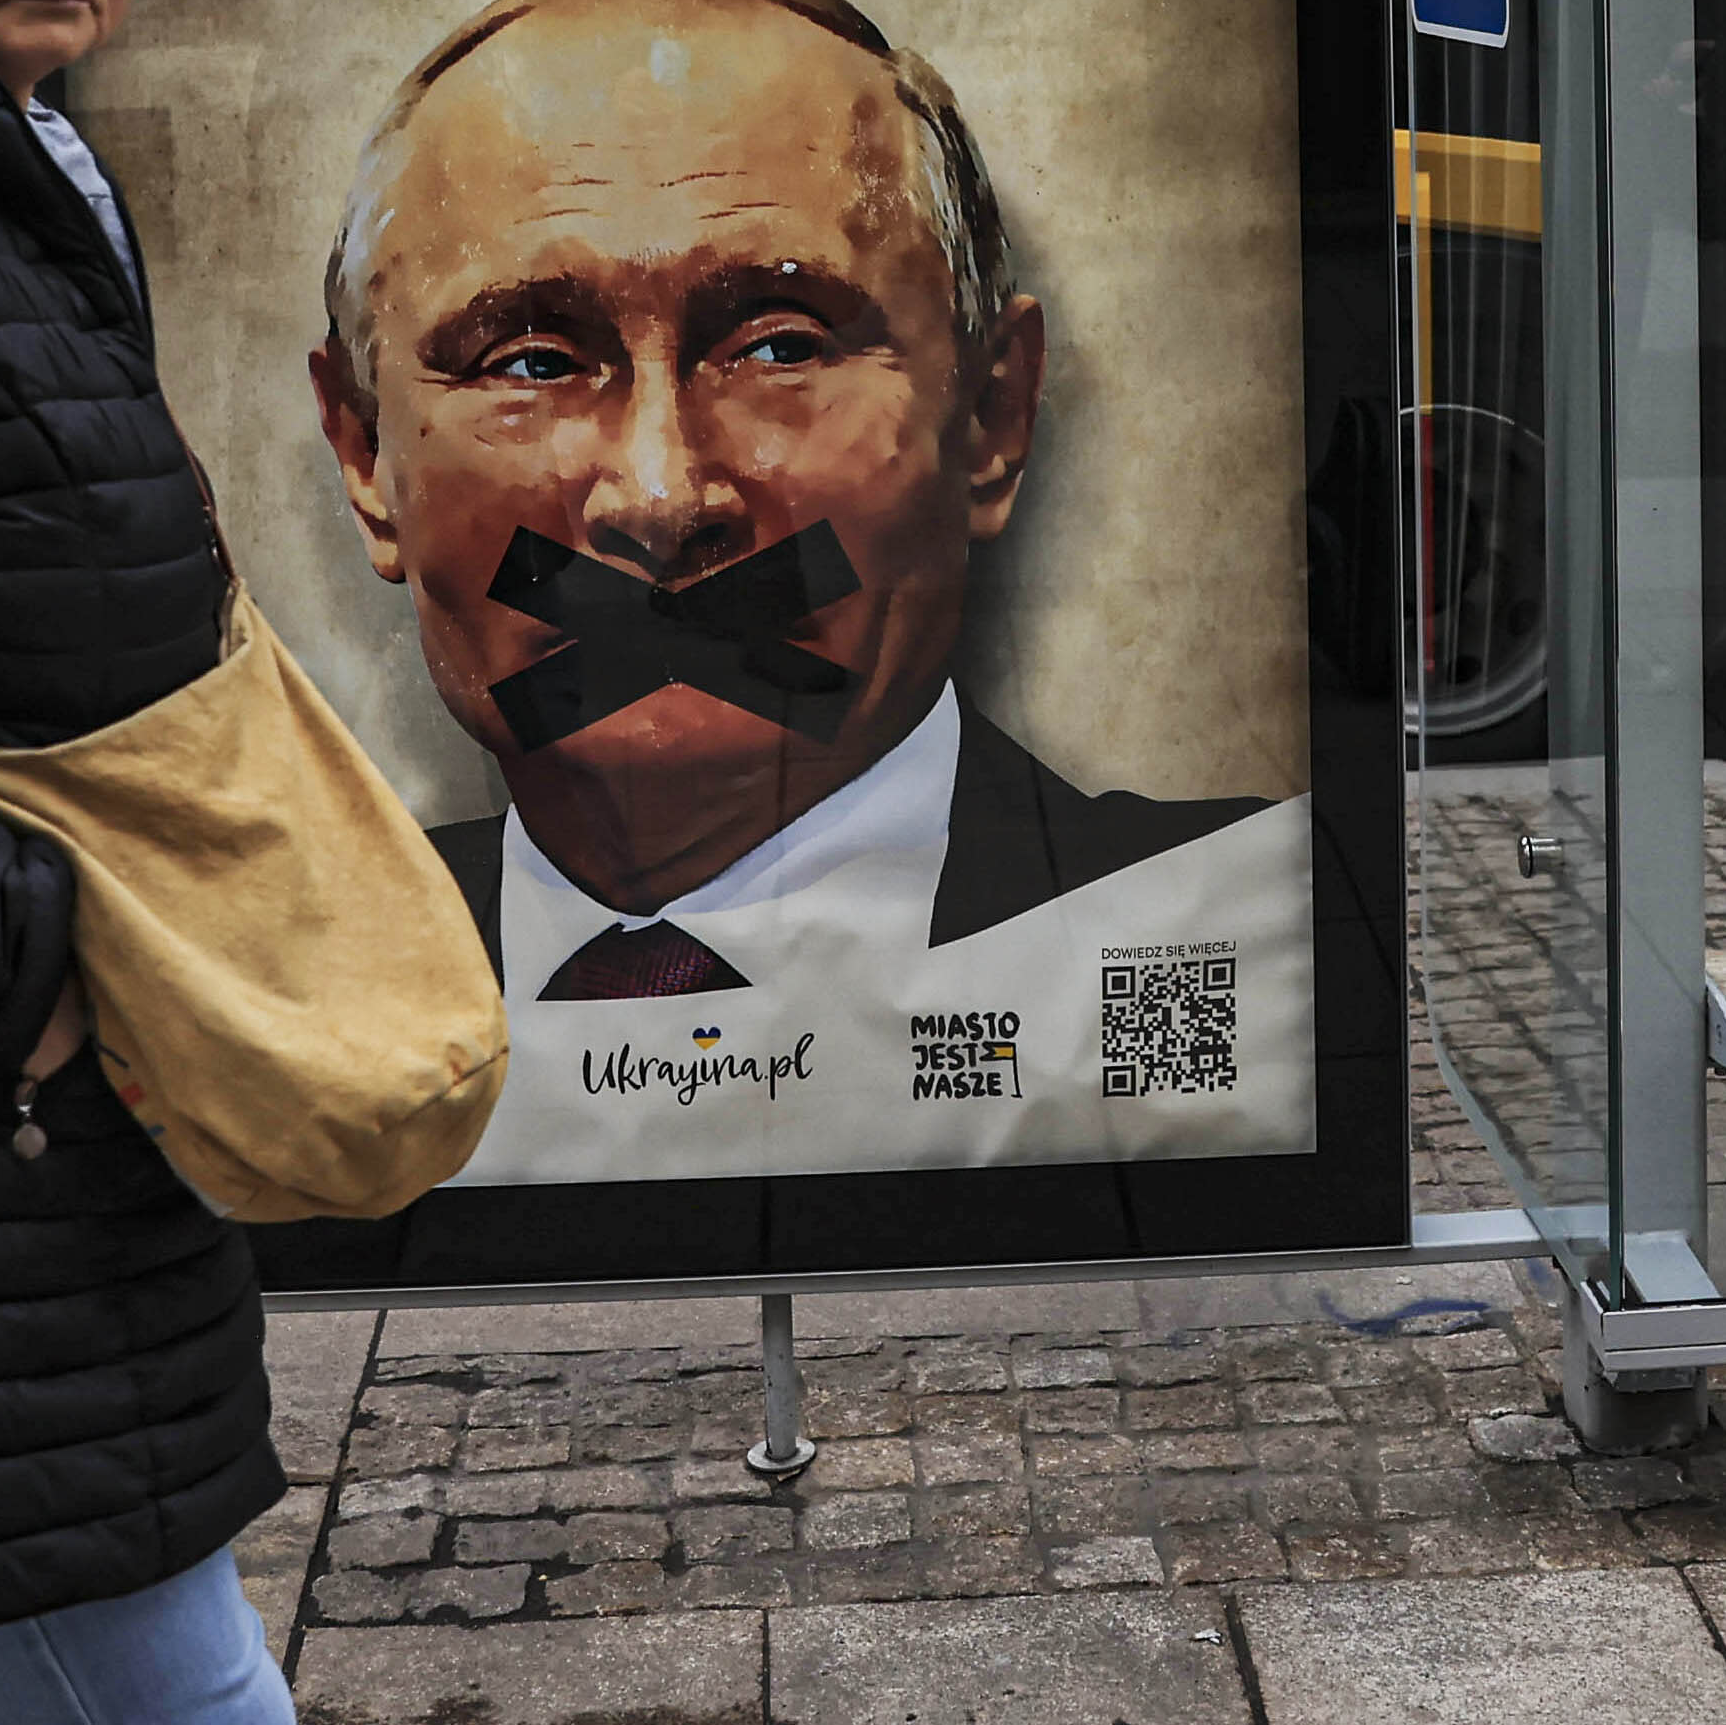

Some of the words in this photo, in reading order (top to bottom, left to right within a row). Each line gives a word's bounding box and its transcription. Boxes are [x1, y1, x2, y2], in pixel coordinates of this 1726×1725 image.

[1101, 946, 1163, 960] DOWIEDZ
[1165, 944, 1186, 958] SIĘ
[1188, 941, 1237, 956] WIĘCEJ
[910, 1011, 1021, 1040] MIASTO
[582, 1030, 815, 1106] Ukrayina.pl
[911, 1042, 980, 1071] JEST
[912, 1072, 1004, 1101] NASZE
